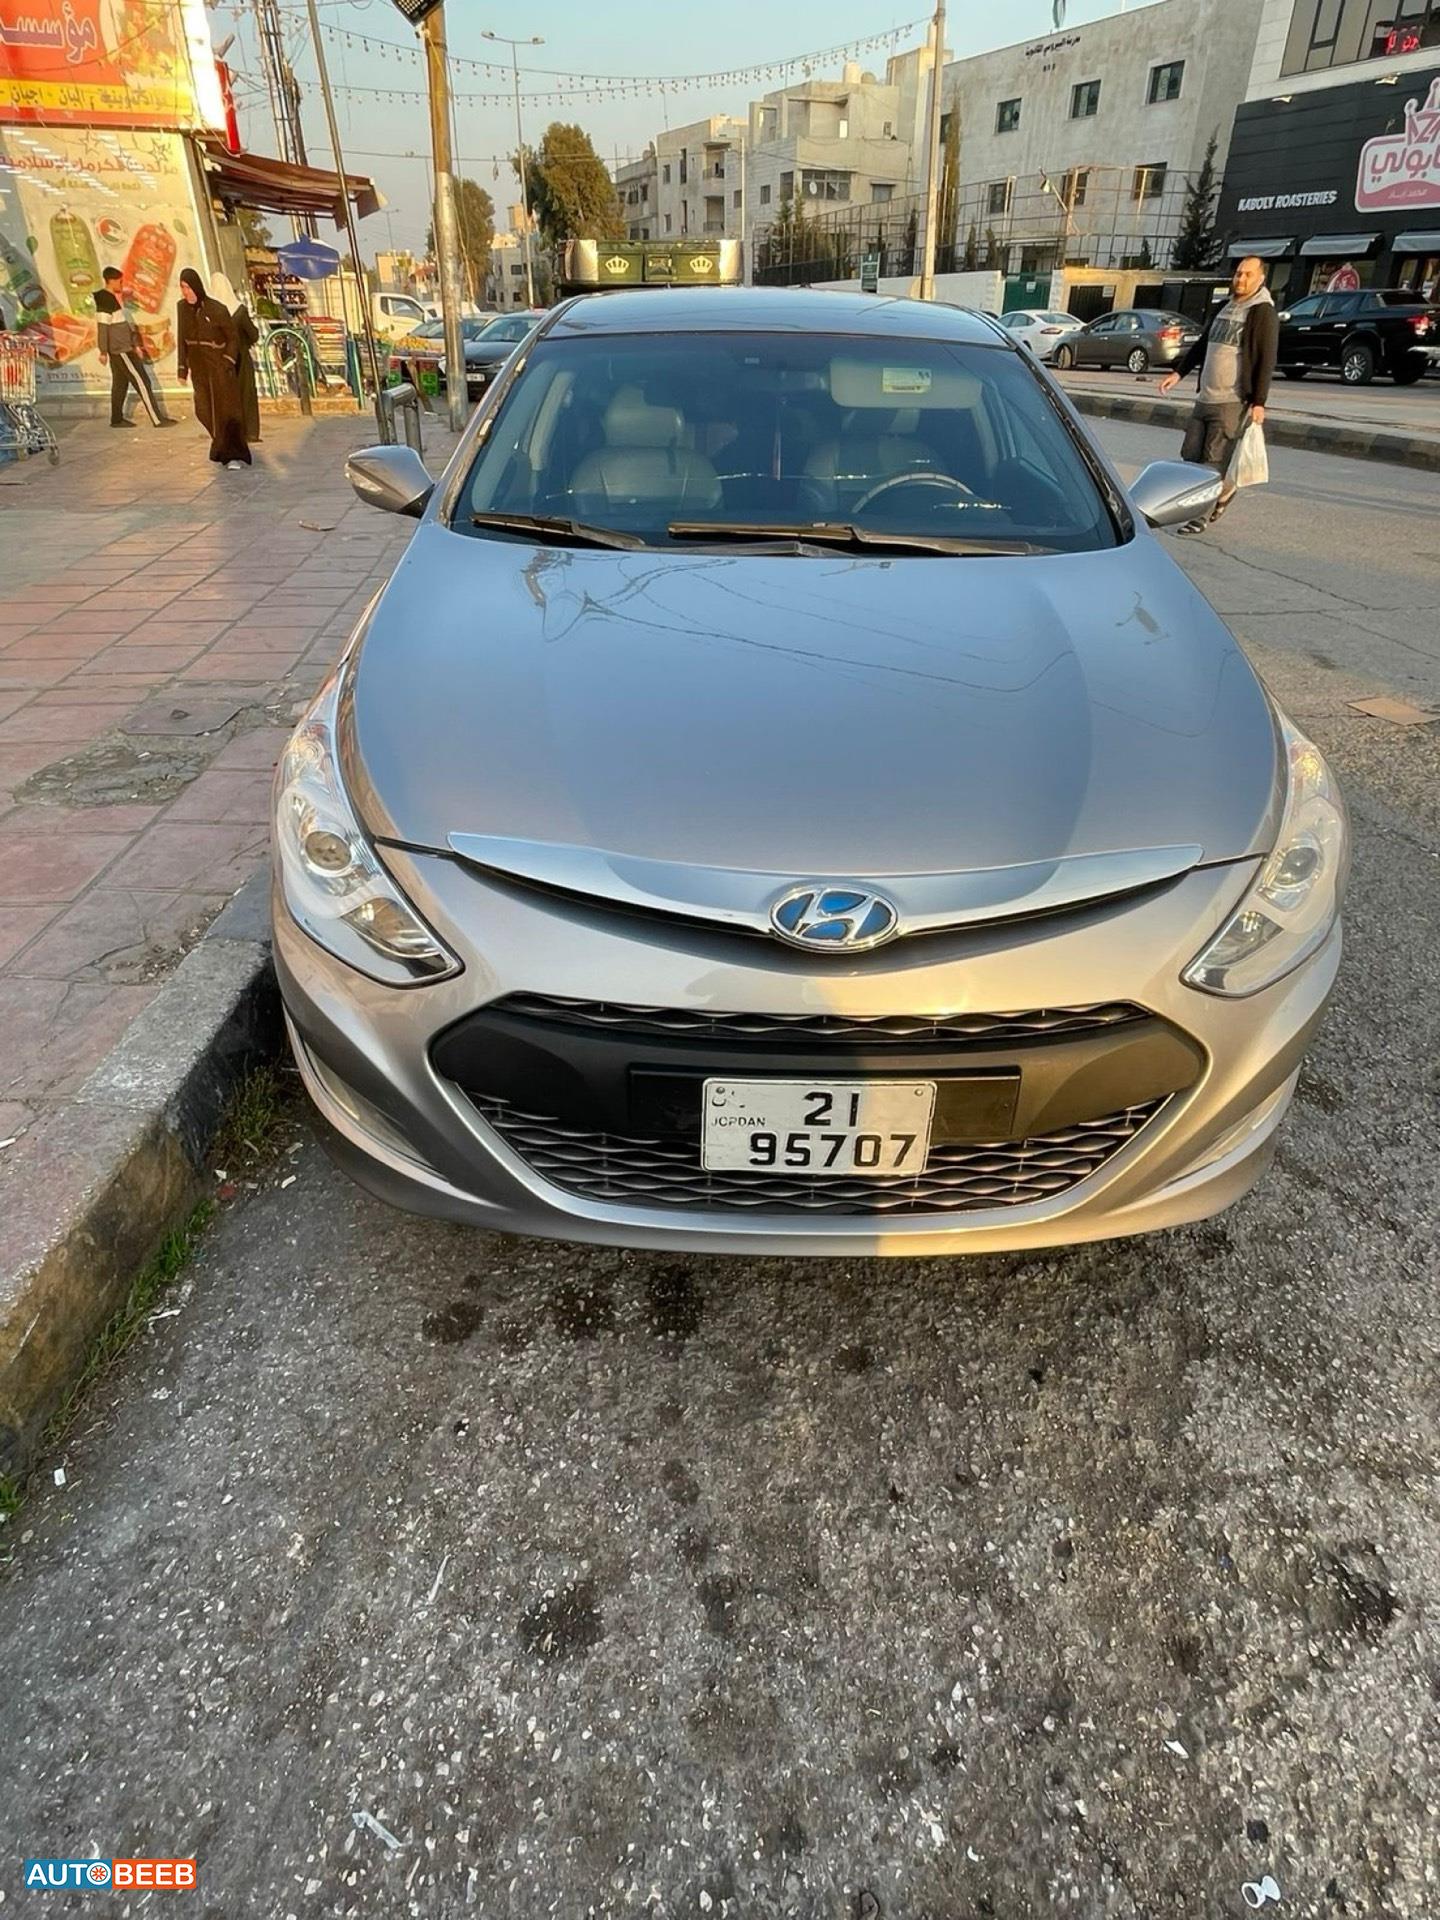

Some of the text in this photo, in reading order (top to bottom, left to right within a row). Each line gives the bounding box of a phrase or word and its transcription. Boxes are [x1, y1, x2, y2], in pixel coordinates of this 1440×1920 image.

[0, 2, 97, 63] مؤسس
[1371, 143, 1440, 184] ابولي
[1238, 190, 1338, 212] KABOLY ROASTERIES
[711, 1116, 766, 1127] JORDAN
[804, 1091, 860, 1127] 21
[749, 1132, 917, 1167] 95707
